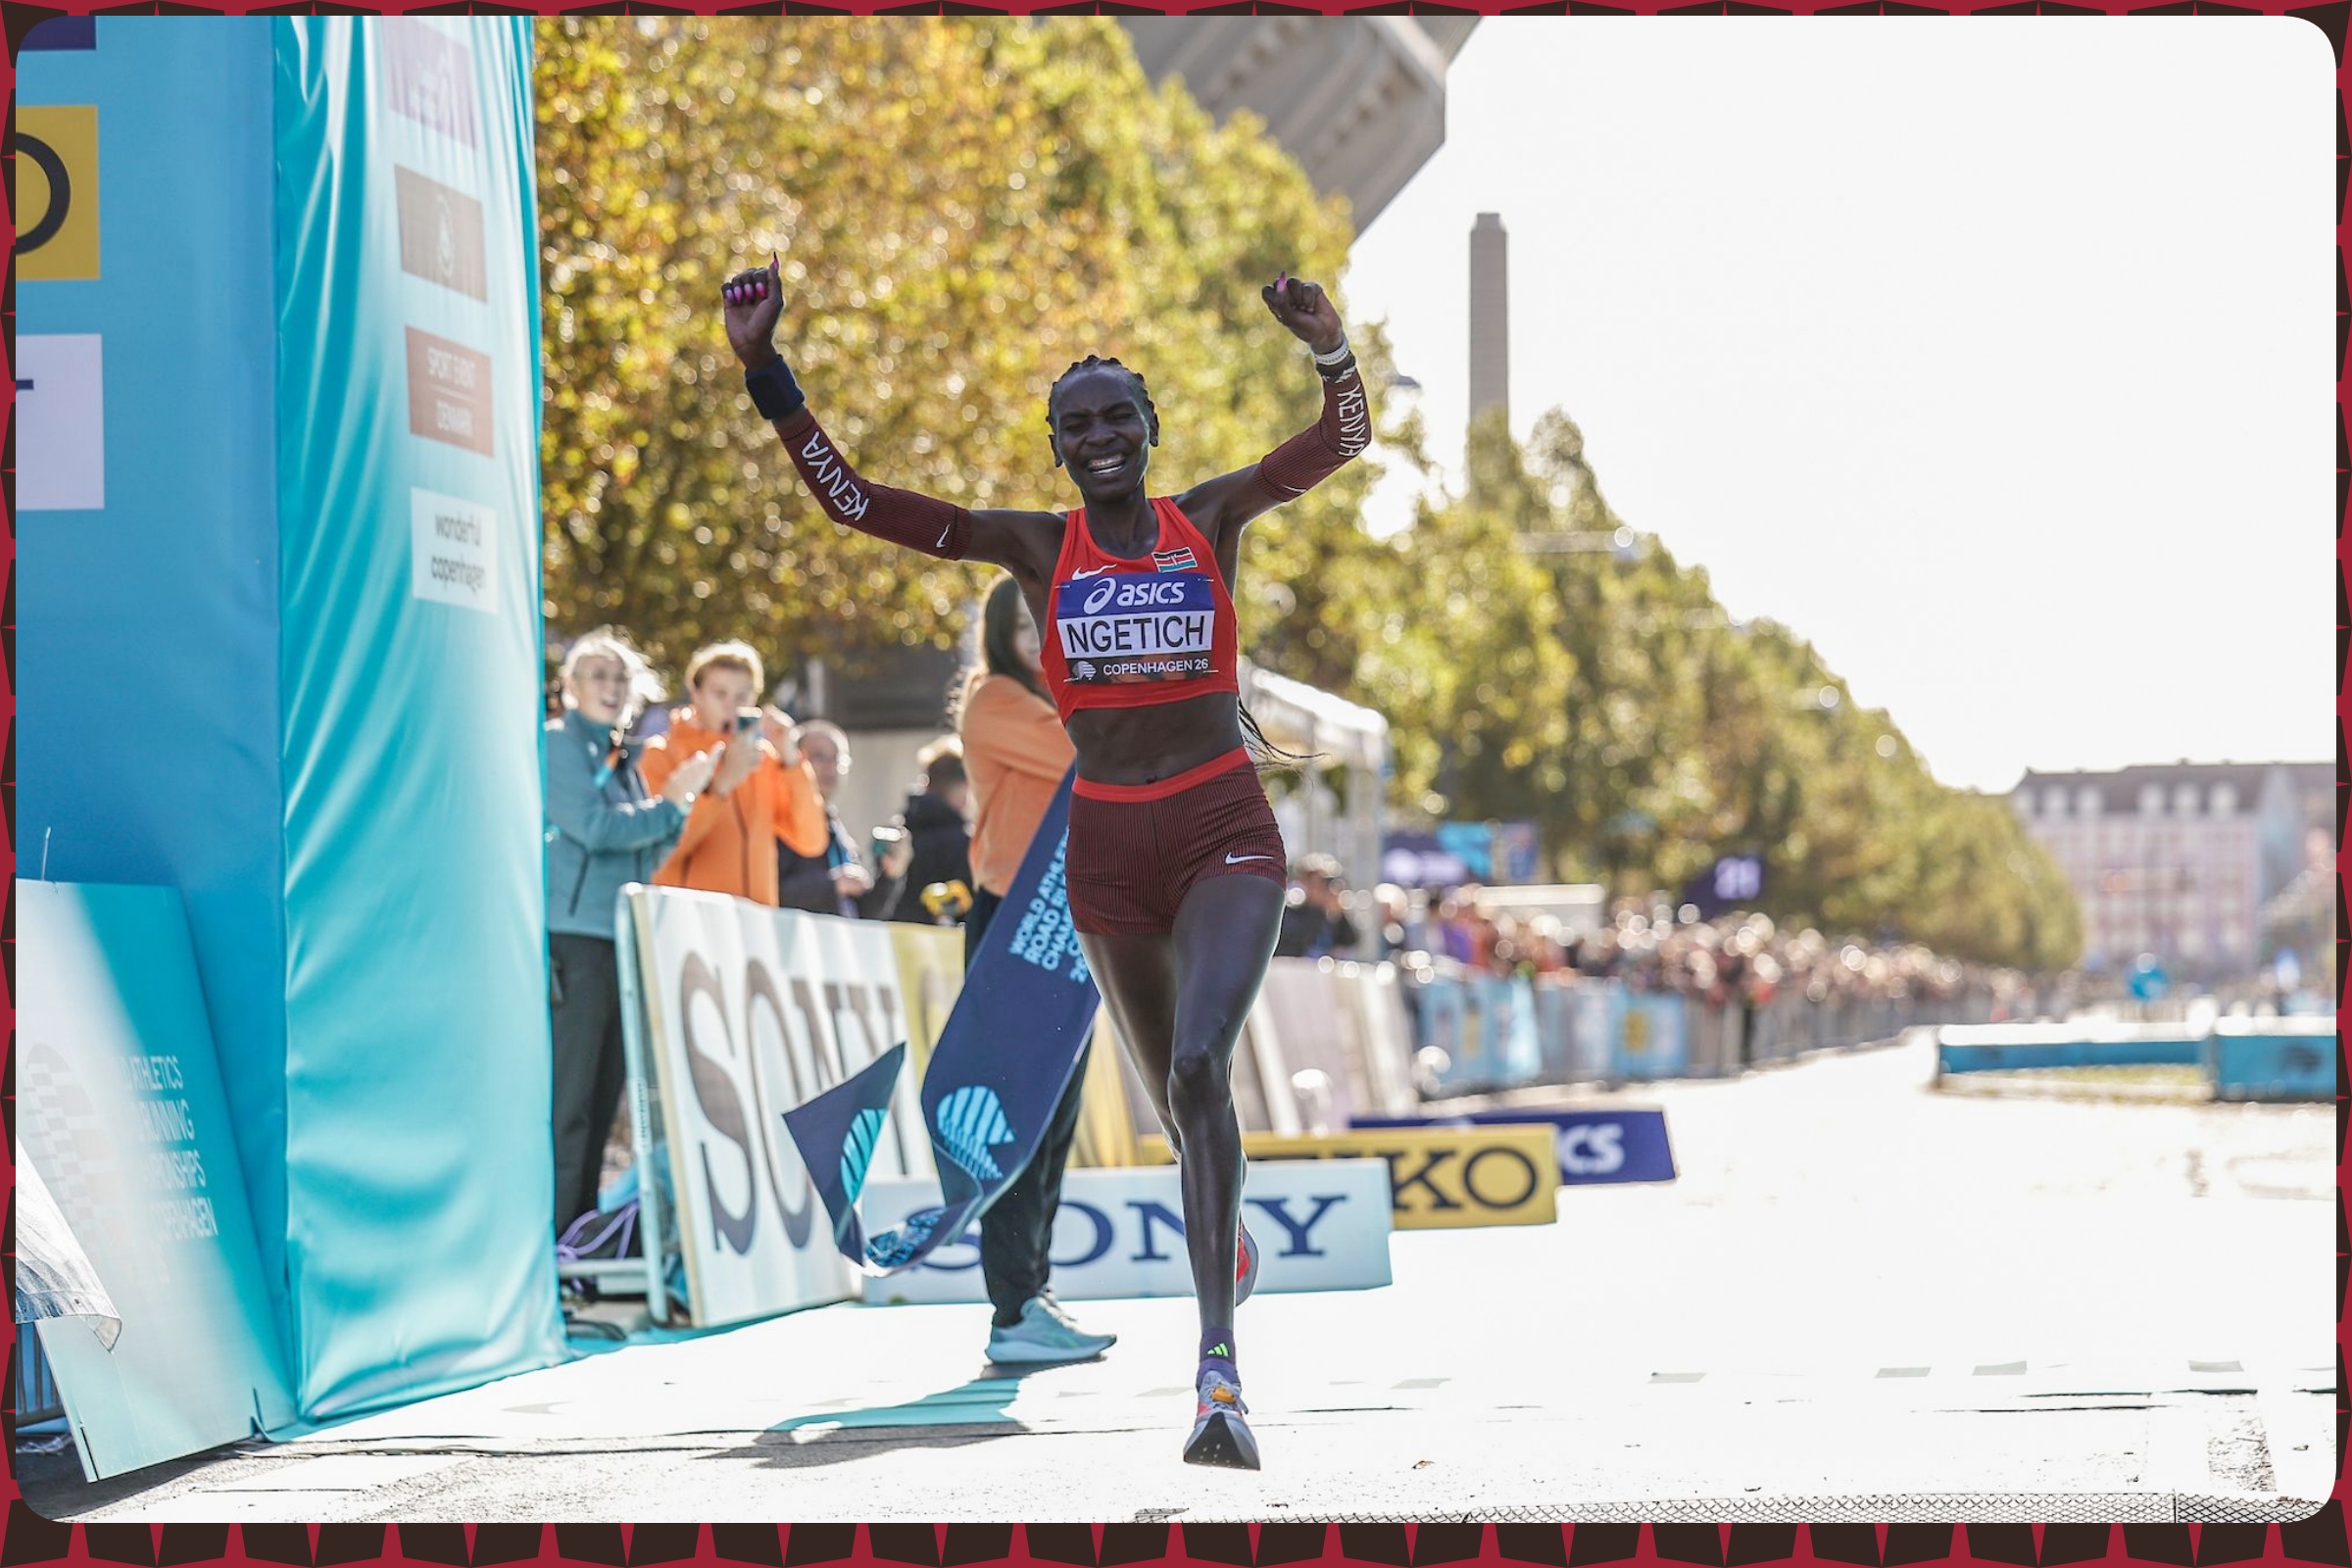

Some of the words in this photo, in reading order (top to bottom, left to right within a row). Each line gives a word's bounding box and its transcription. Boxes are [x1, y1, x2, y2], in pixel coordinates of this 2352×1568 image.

[1337, 382, 1367, 458] KENYA
[801, 430, 870, 521] KENYA
[434, 511, 481, 548] wonderful
[430, 553, 486, 596] copenhagen
[1116, 581, 1185, 607] asics
[1066, 615, 1205, 654] NGETICH
[1102, 660, 1193, 675] COPENHAGEN
[1195, 658, 1209, 671] 26
[1008, 897, 1047, 956] WORLD
[1037, 826, 1069, 900] ATHLE
[1023, 907, 1061, 965] ROAD
[127, 1054, 184, 1091] ATHLETICS
